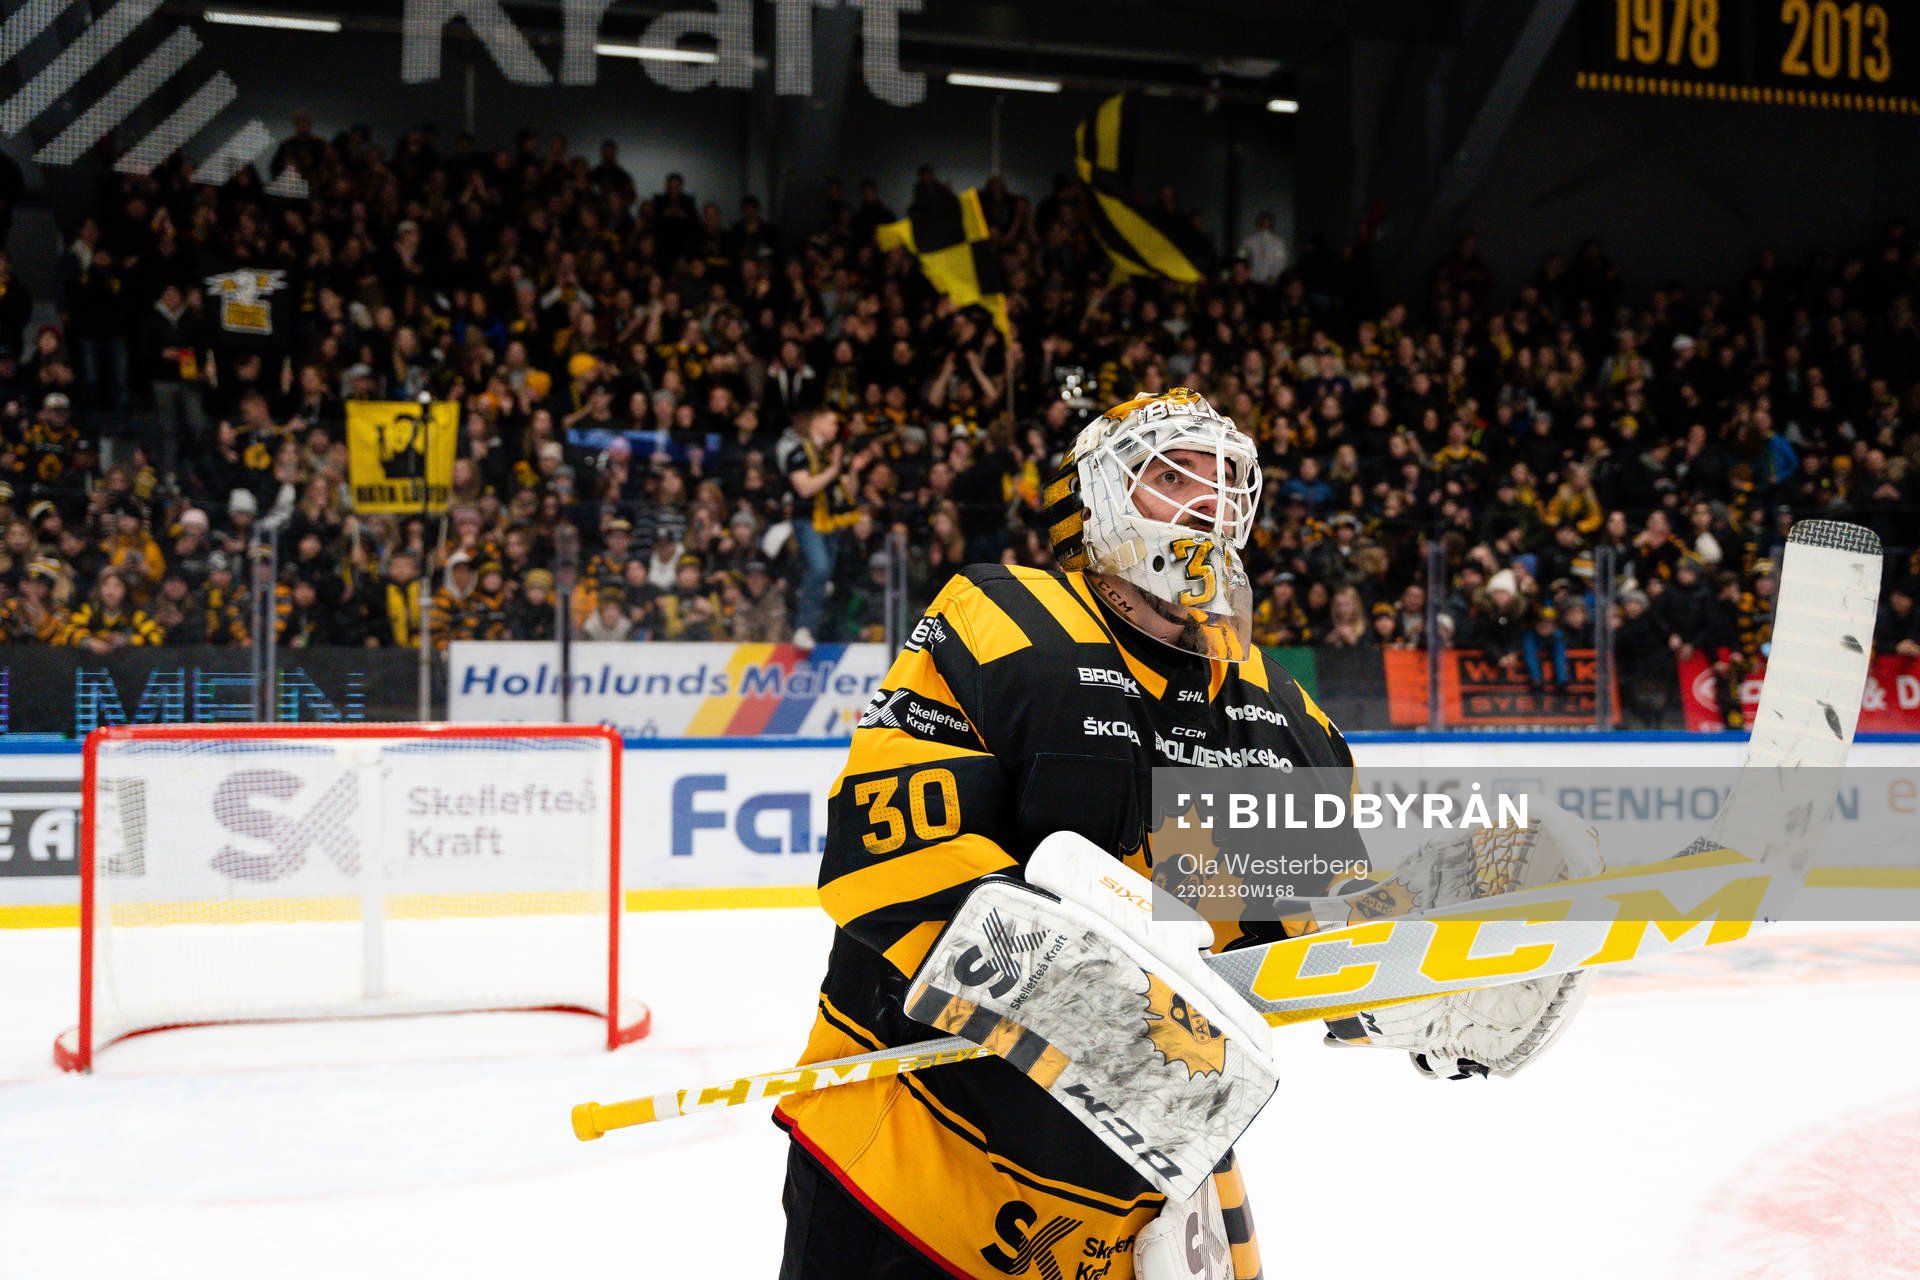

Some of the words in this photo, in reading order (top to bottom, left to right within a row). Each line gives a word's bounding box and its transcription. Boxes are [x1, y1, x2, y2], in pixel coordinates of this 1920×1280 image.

[1616, 0, 1720, 69] 1978
[1780, 0, 1891, 83] 2013
[461, 663, 730, 698] Holmlunds
[1177, 690, 1205, 703] SHL
[906, 713, 937, 737] Kraft
[908, 701, 970, 733] Skellefteå
[1171, 726, 1207, 740] CCM
[405, 780, 597, 819] Skellefteå
[855, 767, 962, 856] 30
[408, 828, 502, 860] Kraft
[1252, 875, 1772, 1003] CCM
[1010, 961, 1050, 1011] Skellefteå
[1043, 934, 1069, 963] Kraft
[680, 1062, 872, 1114] CCM
[1062, 1082, 1183, 1183] CCM
